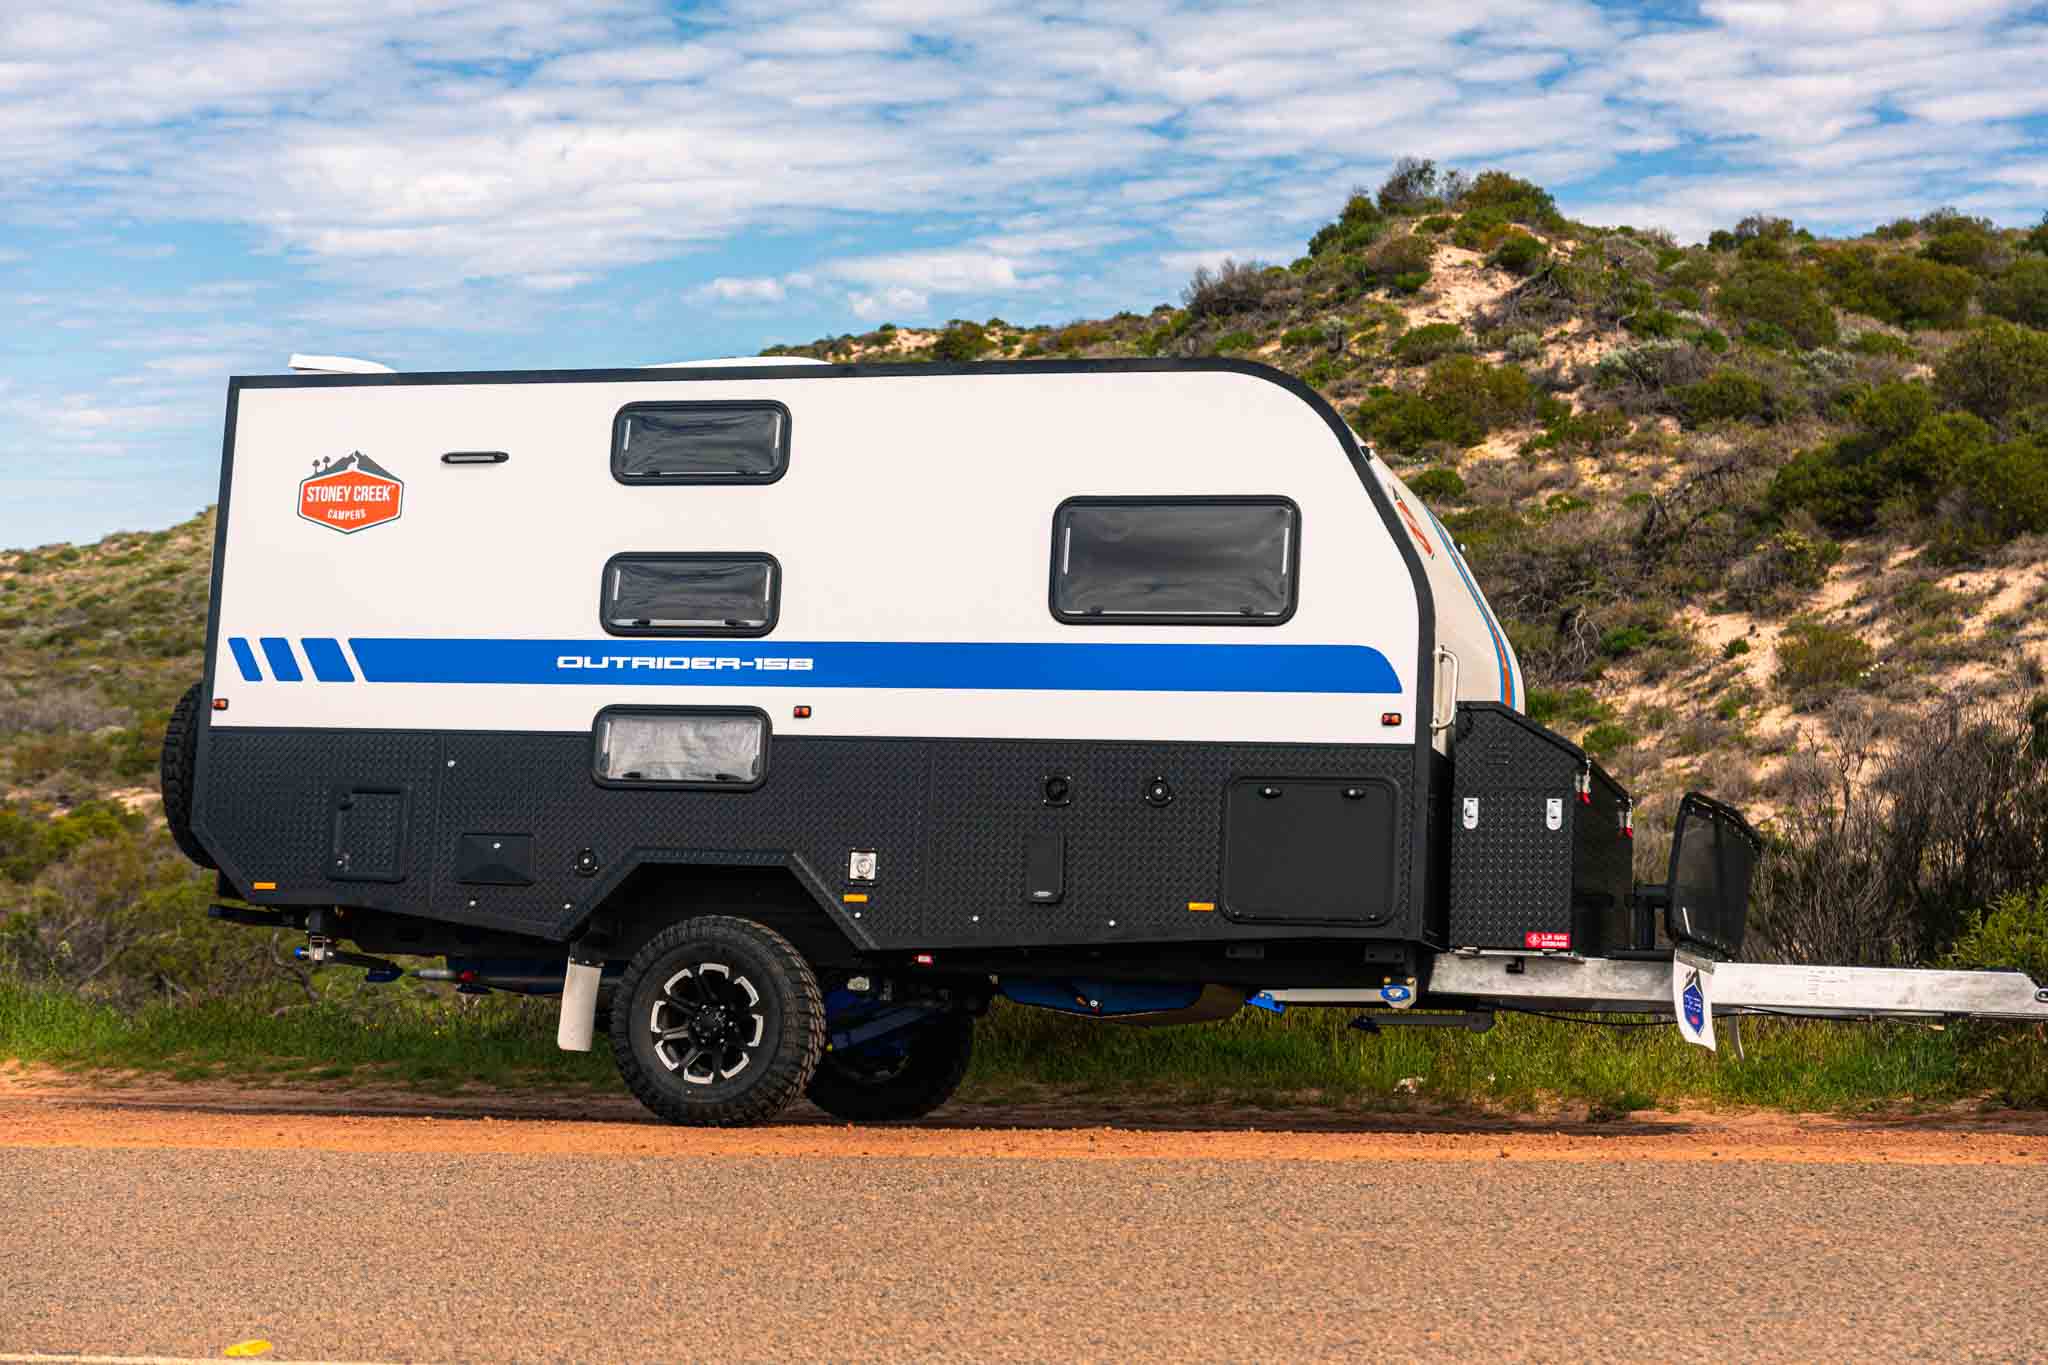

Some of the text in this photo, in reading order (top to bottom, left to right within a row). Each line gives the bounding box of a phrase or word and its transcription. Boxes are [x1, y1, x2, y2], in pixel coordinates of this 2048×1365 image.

[306, 485, 391, 503] STONEY CREEK
[327, 508, 367, 521] CAMPERS
